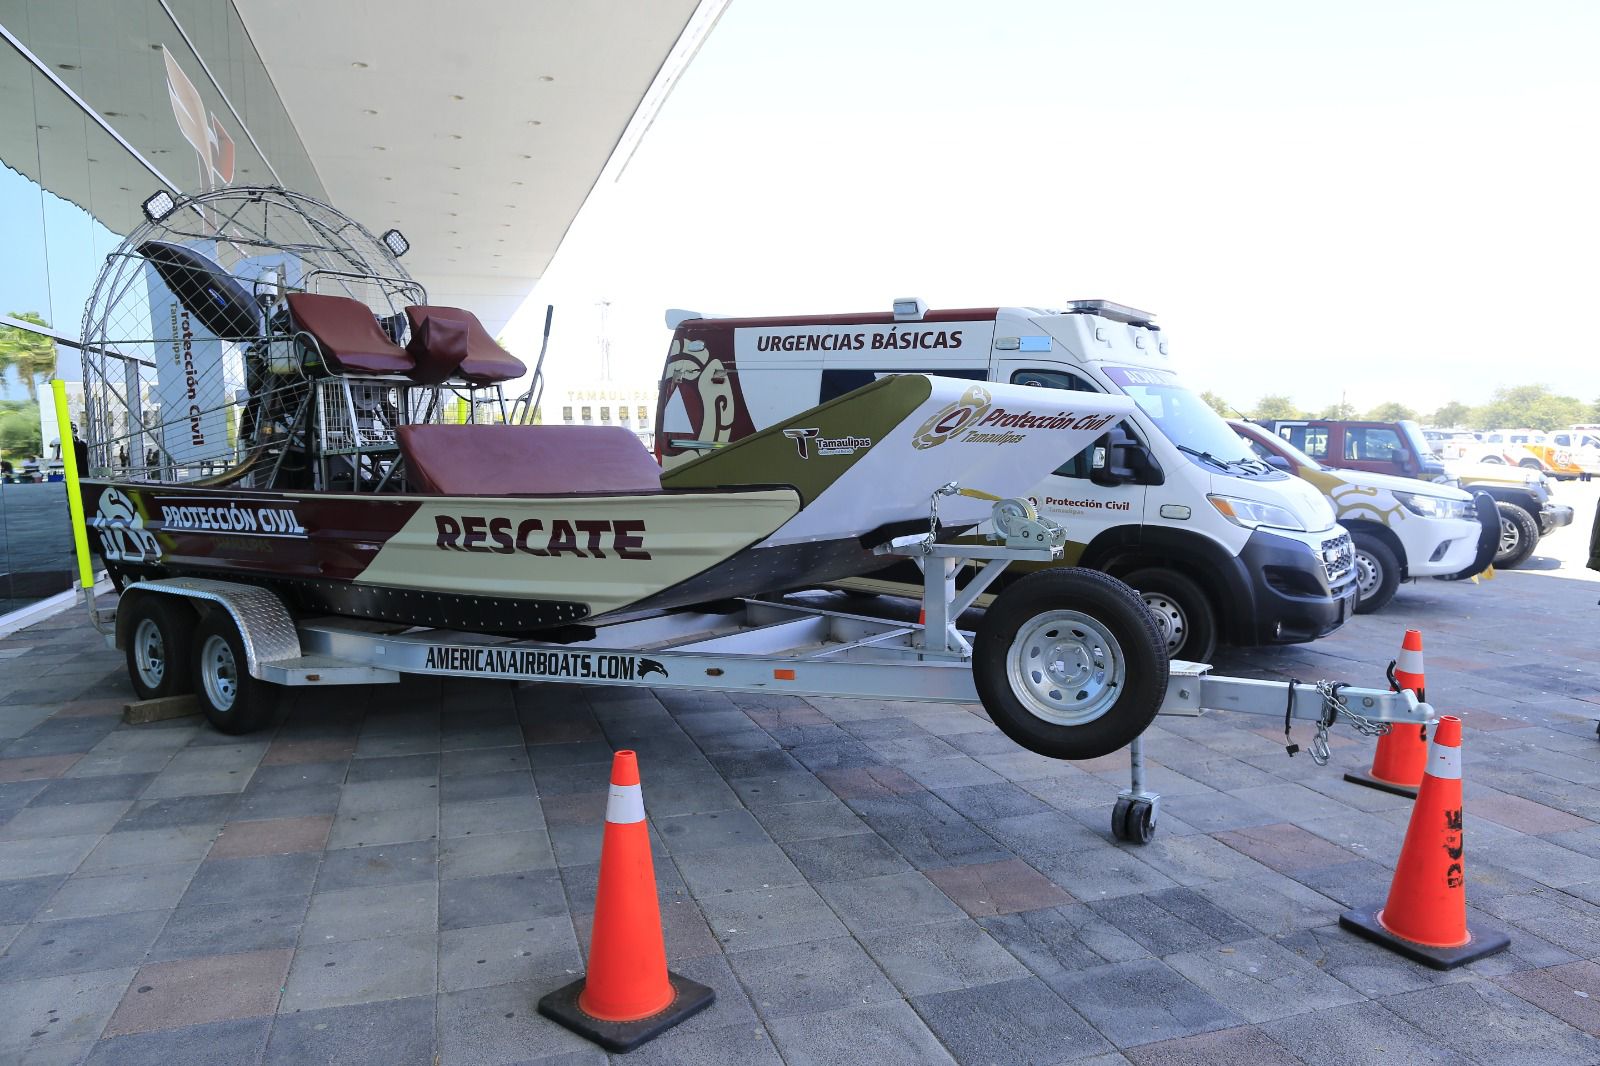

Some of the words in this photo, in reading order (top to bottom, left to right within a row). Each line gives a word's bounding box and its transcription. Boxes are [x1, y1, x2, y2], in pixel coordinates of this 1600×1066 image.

[180, 303, 199, 400] rotección
[757, 333, 865, 352] URGENCIAS
[871, 326, 963, 350] BÁSICAS
[189, 404, 205, 446] Civil
[978, 408, 1076, 431] Protección
[1071, 414, 1116, 431] Civil
[816, 436, 871, 450] Tamaulipas
[960, 430, 1026, 446] Tamaulipas
[161, 502, 257, 531] PROTECCIÓN
[257, 508, 305, 534] CIVIL
[1045, 496, 1103, 509] Protección
[1105, 501, 1130, 511] Civil
[434, 514, 652, 560] RESCATE
[424, 646, 635, 680] AMERICANAIRBOATS.COM
